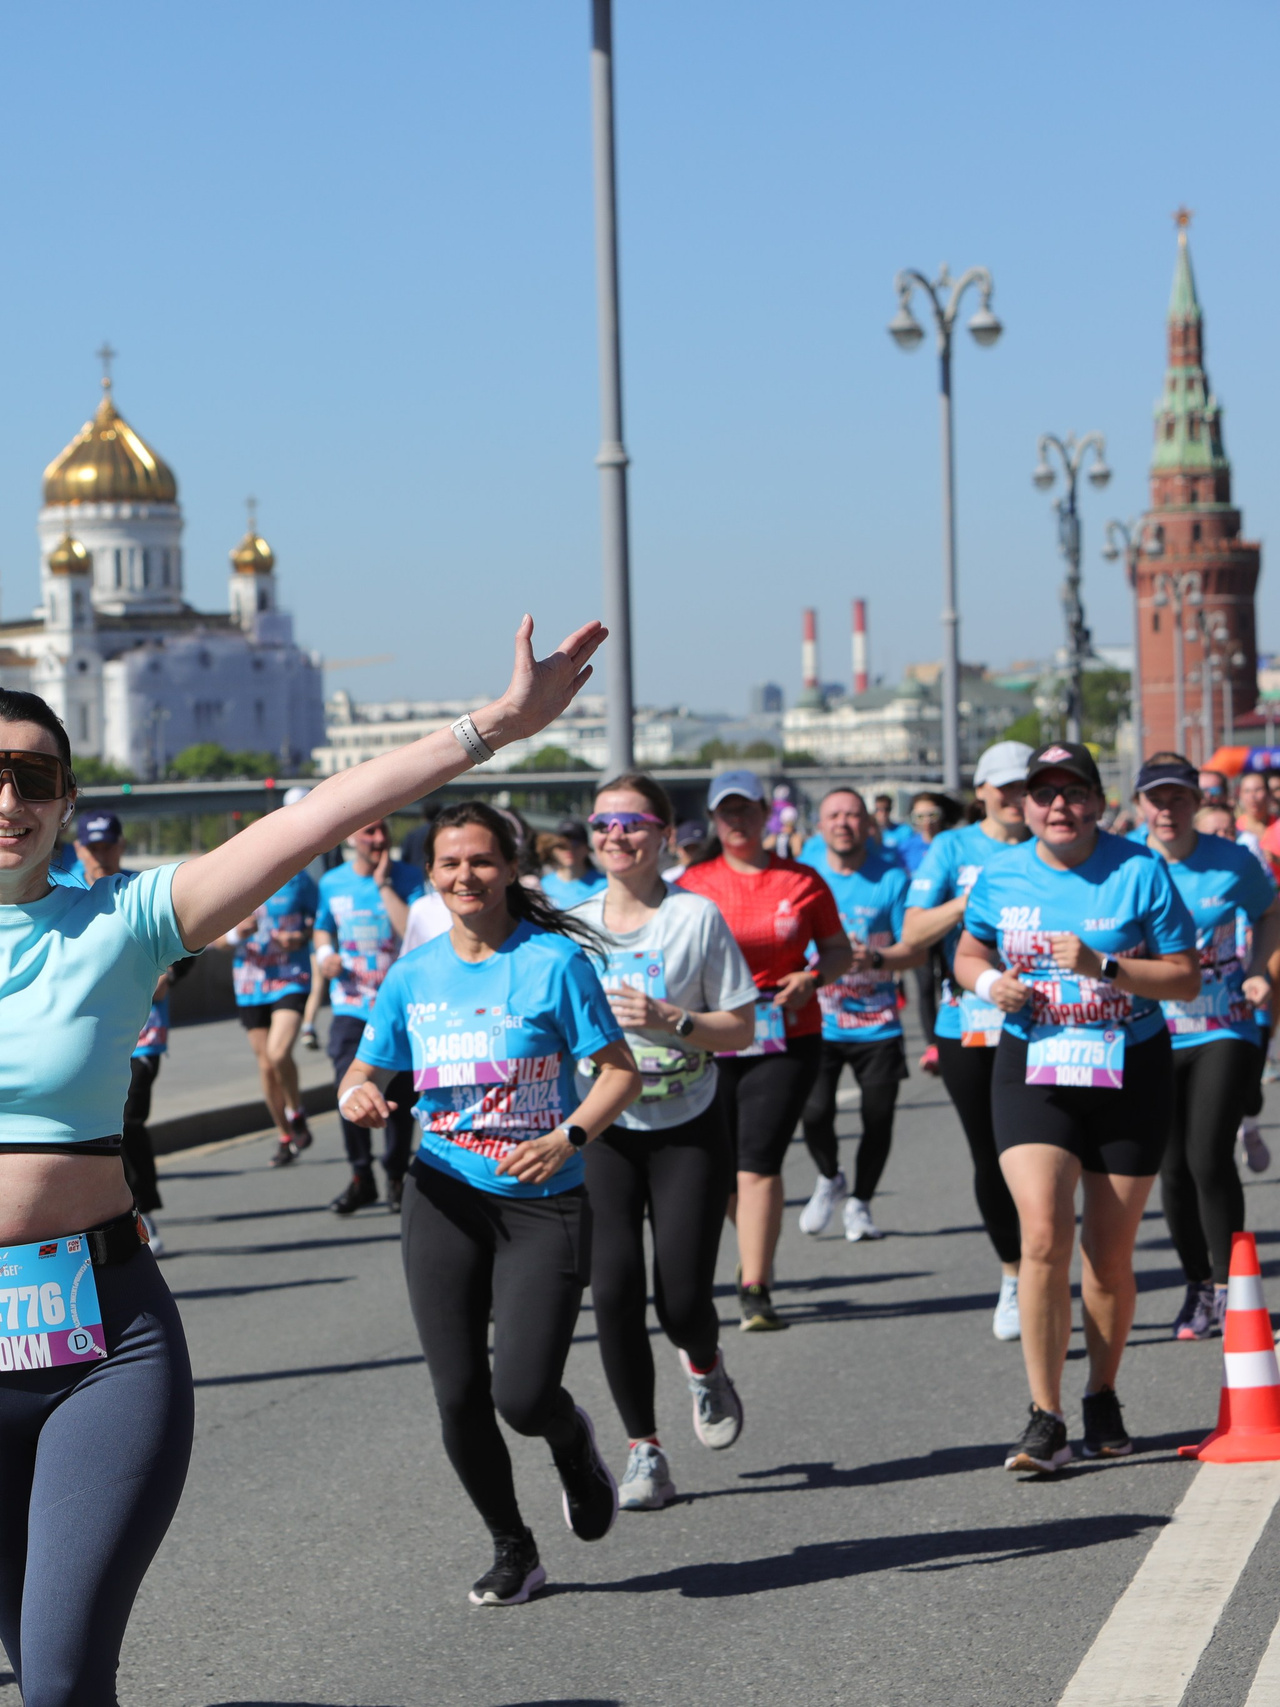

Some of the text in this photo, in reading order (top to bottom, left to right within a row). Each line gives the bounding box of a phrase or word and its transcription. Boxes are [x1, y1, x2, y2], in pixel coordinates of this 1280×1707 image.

[997, 905, 1042, 931] 2024
[426, 1031, 489, 1064] 34608
[1045, 1039, 1105, 1065] 30775
[437, 1062, 476, 1088] 10KM
[1055, 1065, 1094, 1087] 10KM
[74, 1334, 88, 1350] D
